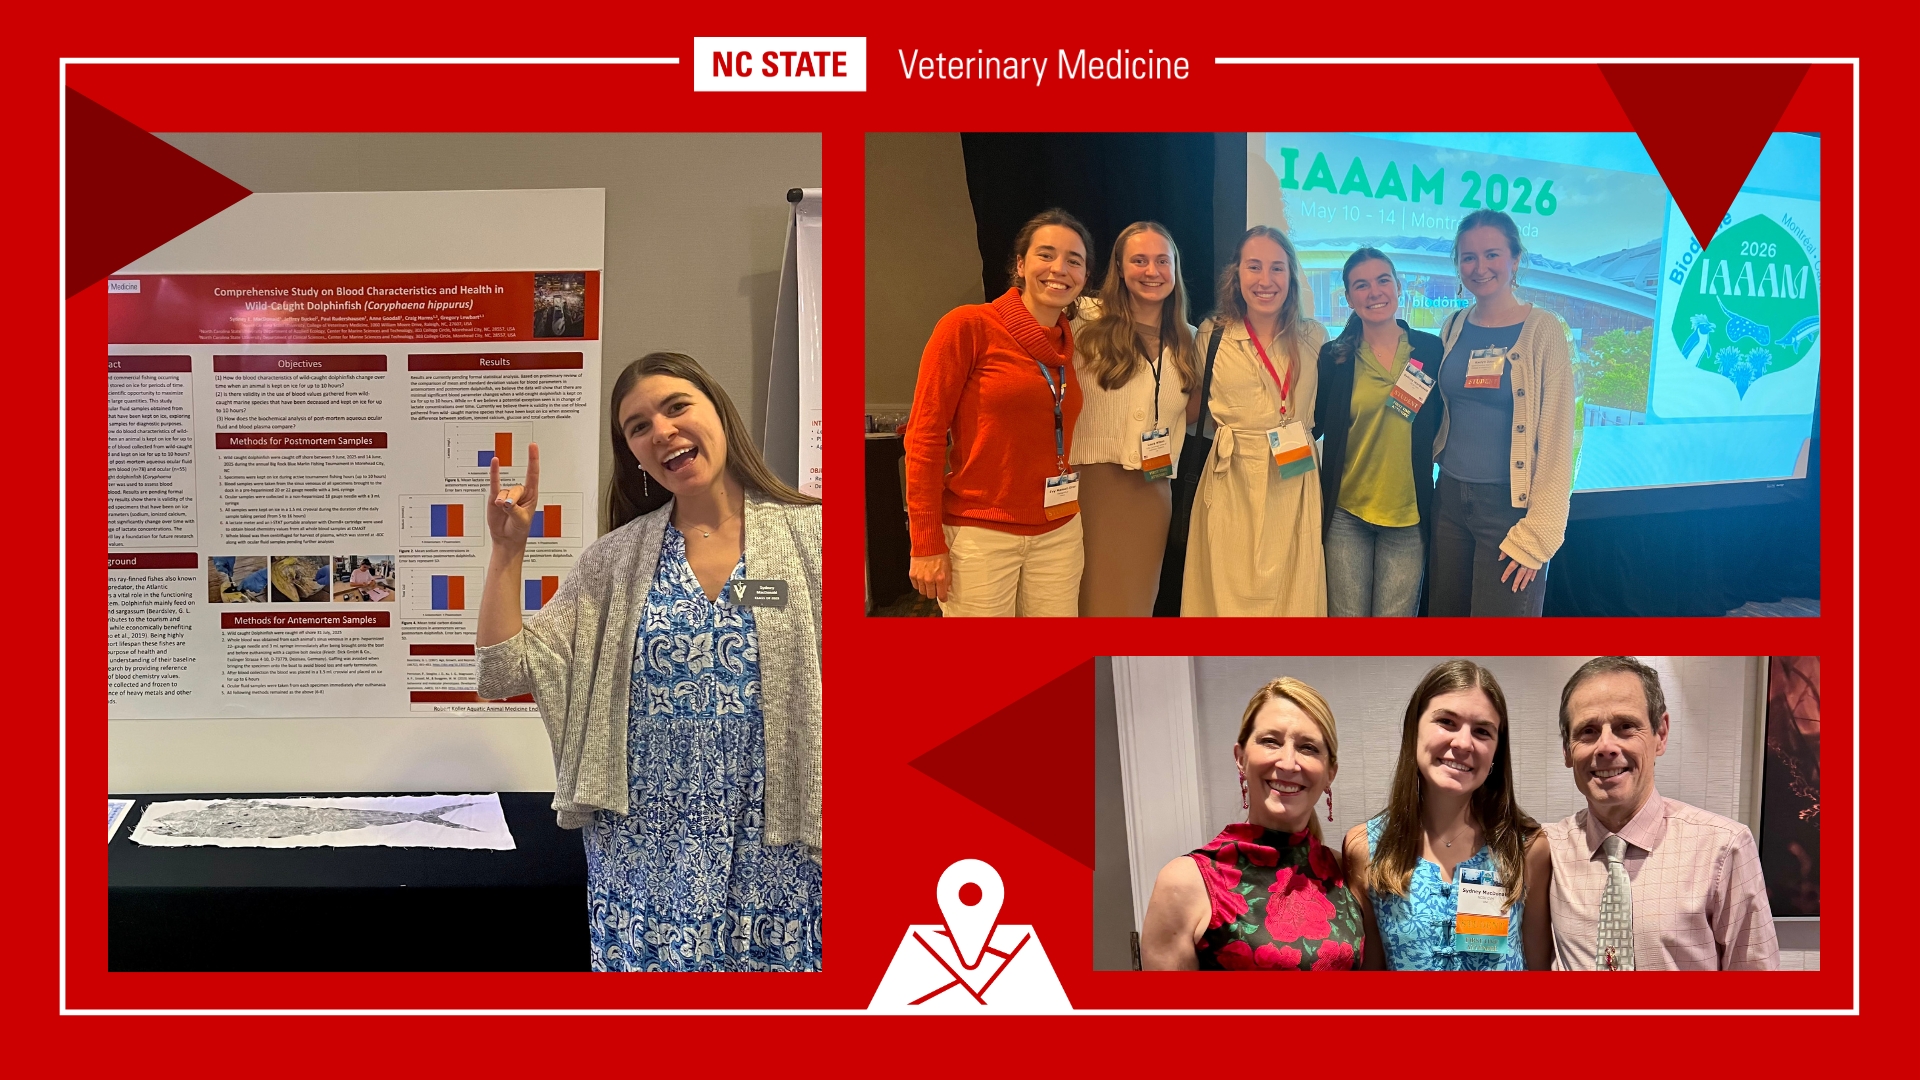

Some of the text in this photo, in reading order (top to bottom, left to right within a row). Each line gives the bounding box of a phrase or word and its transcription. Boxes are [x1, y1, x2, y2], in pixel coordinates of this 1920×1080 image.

[1280, 147, 1557, 216] IAAAM 2026
[1300, 200, 1336, 223] May
[1342, 206, 1360, 221] 10
[1379, 208, 1396, 225] 14
[1782, 212, 1816, 254] Montréal
[1740, 241, 1776, 258] 2026
[1700, 258, 1809, 299] IAAAM
[111, 282, 138, 291] Medicine
[214, 287, 288, 298] Comprehensive
[292, 287, 318, 298] Study
[337, 287, 364, 295] Blood
[367, 286, 436, 295] Characteristics
[440, 286, 458, 294] and
[460, 285, 492, 294] Health
[495, 285, 504, 293] in
[245, 299, 473, 312] Wild-Caught Dolphinfish (Coryphaena hippurus)
[278, 360, 322, 369] Objectives
[480, 358, 510, 366] Results
[1394, 390, 1418, 408] STUDENT
[230, 437, 267, 445] Methods
[338, 437, 372, 446] Samples
[343, 616, 376, 625] Samples
[1462, 920, 1504, 930] STUDENT
